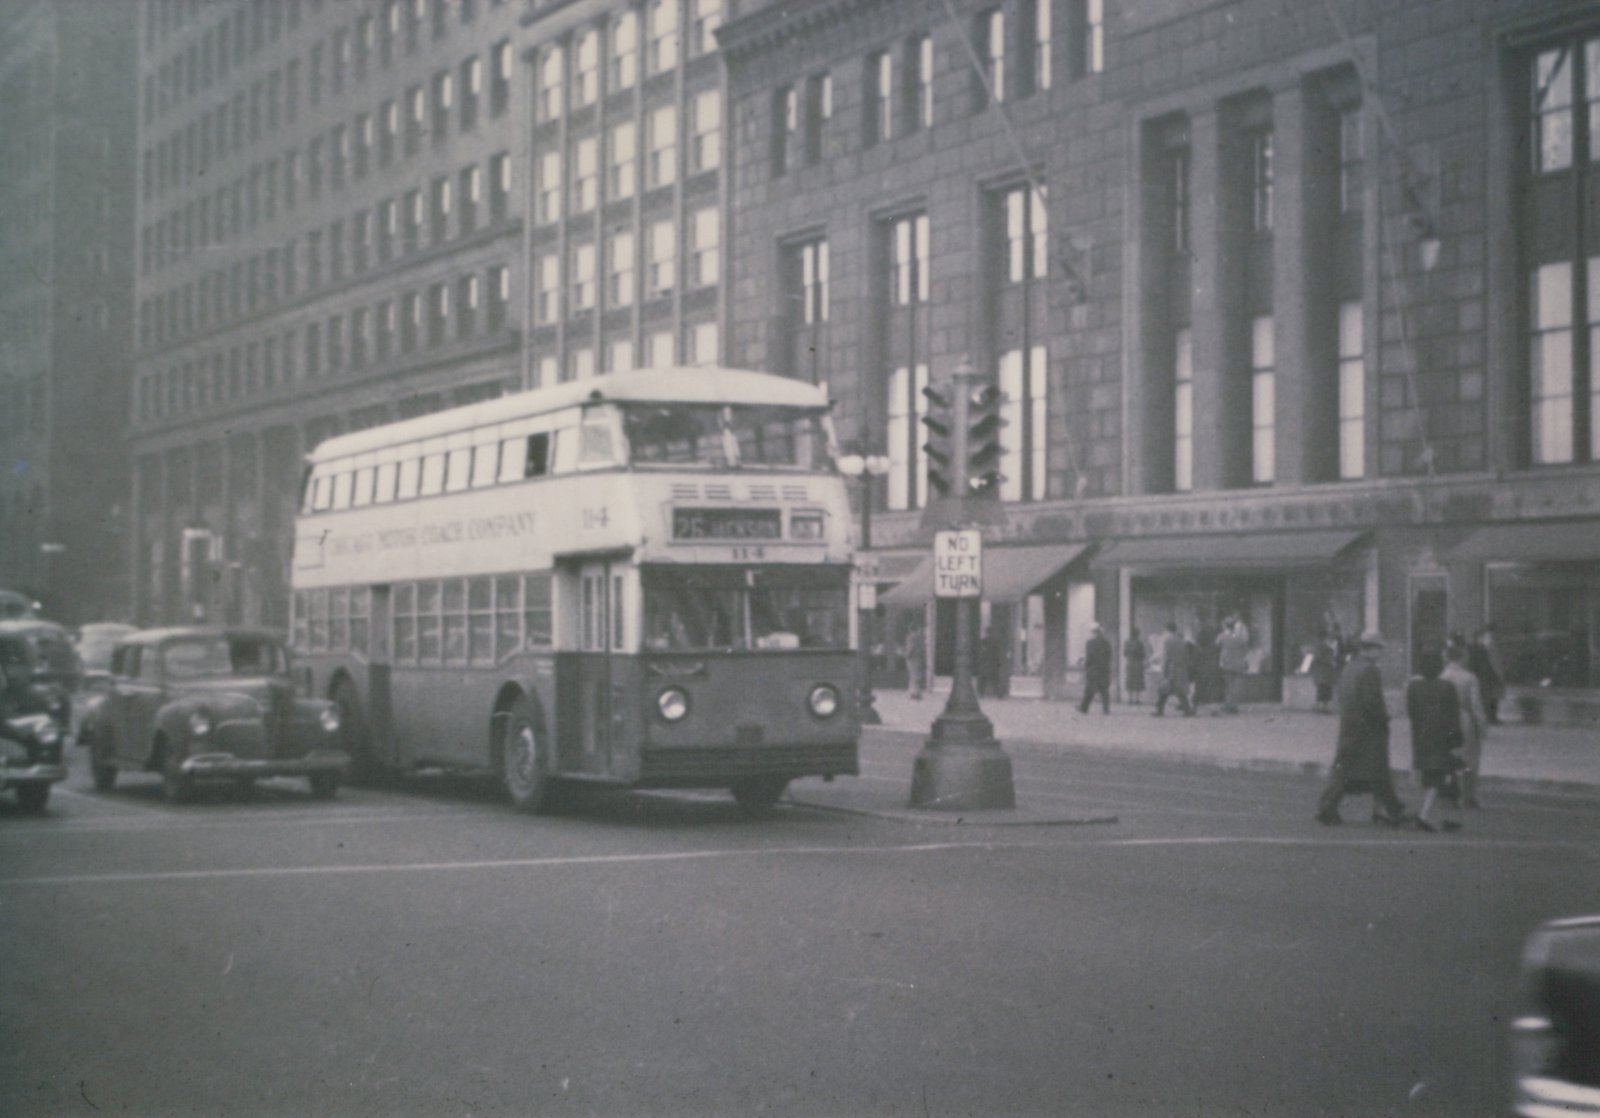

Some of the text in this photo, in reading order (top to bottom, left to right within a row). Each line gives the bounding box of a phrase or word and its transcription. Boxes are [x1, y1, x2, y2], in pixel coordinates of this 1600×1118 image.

[582, 505, 610, 529] 114
[421, 521, 465, 545] COACH
[467, 512, 537, 540] COMPANY
[947, 537, 969, 551] NO
[731, 547, 765, 560] 114
[938, 556, 977, 571] LEFT
[939, 574, 979, 590] TURN
